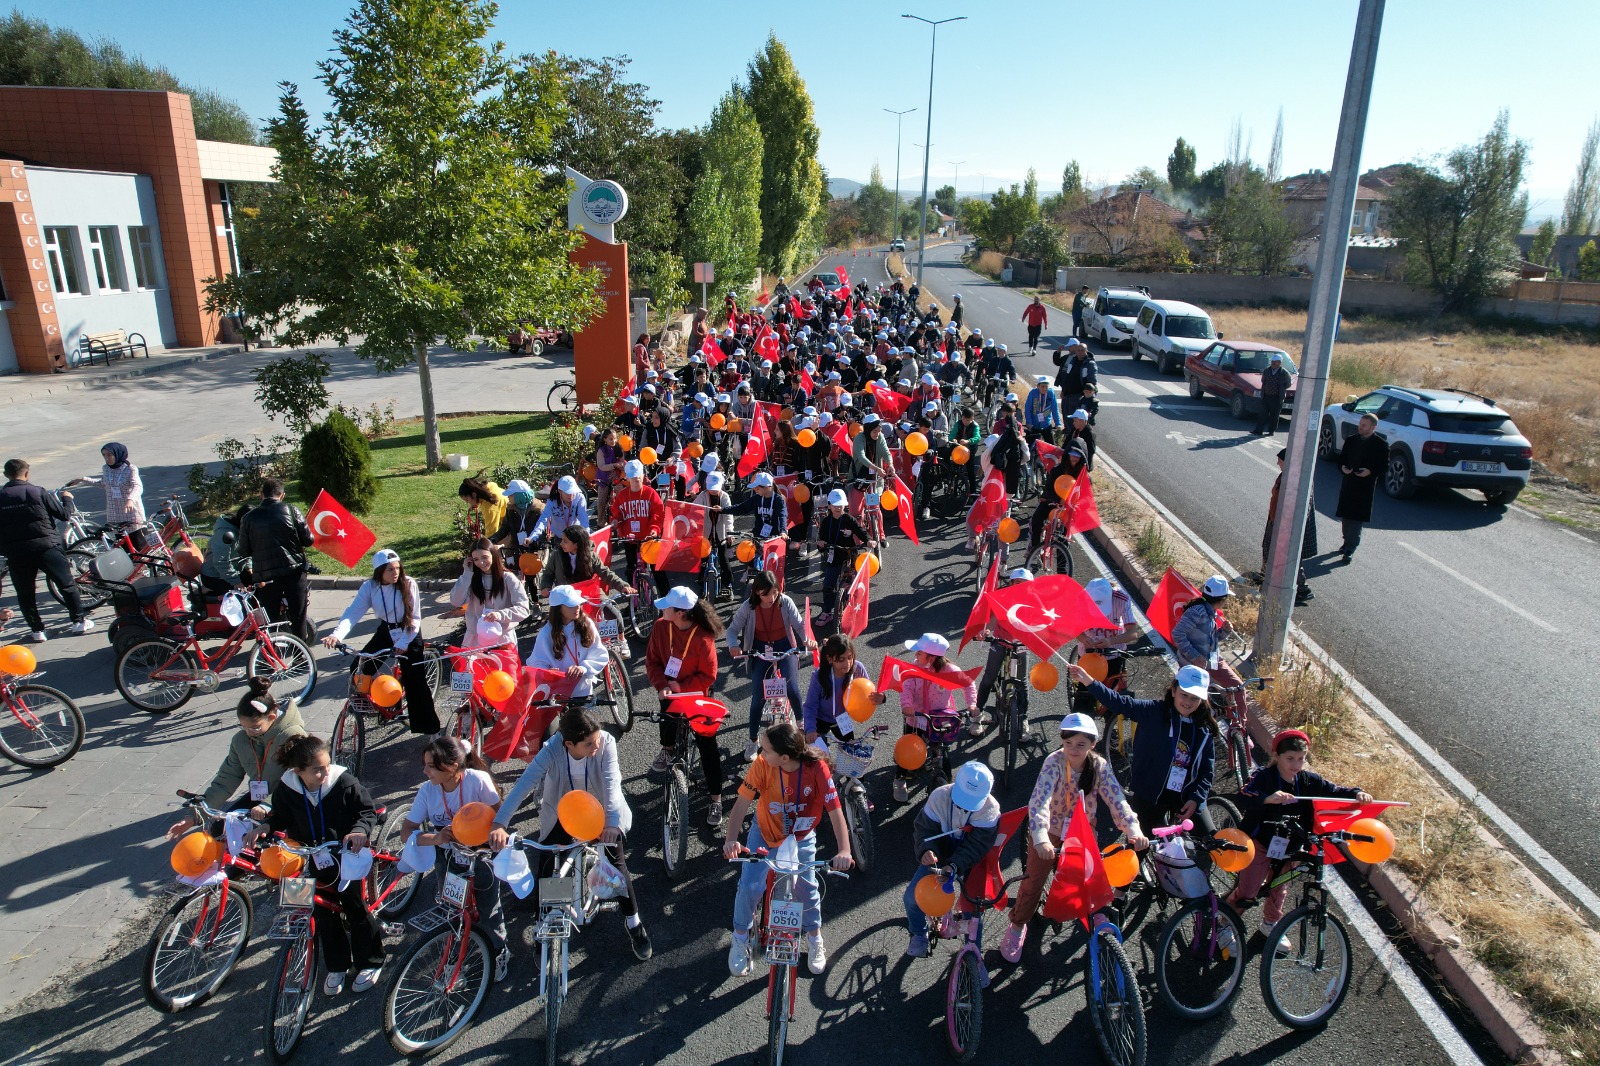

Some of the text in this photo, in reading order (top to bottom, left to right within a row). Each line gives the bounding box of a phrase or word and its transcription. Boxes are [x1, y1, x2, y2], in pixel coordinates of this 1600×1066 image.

[453, 682, 471, 690] 0013
[766, 688, 785, 696] 0728
[444, 887, 464, 902] 0046
[772, 915, 799, 927] 0510
